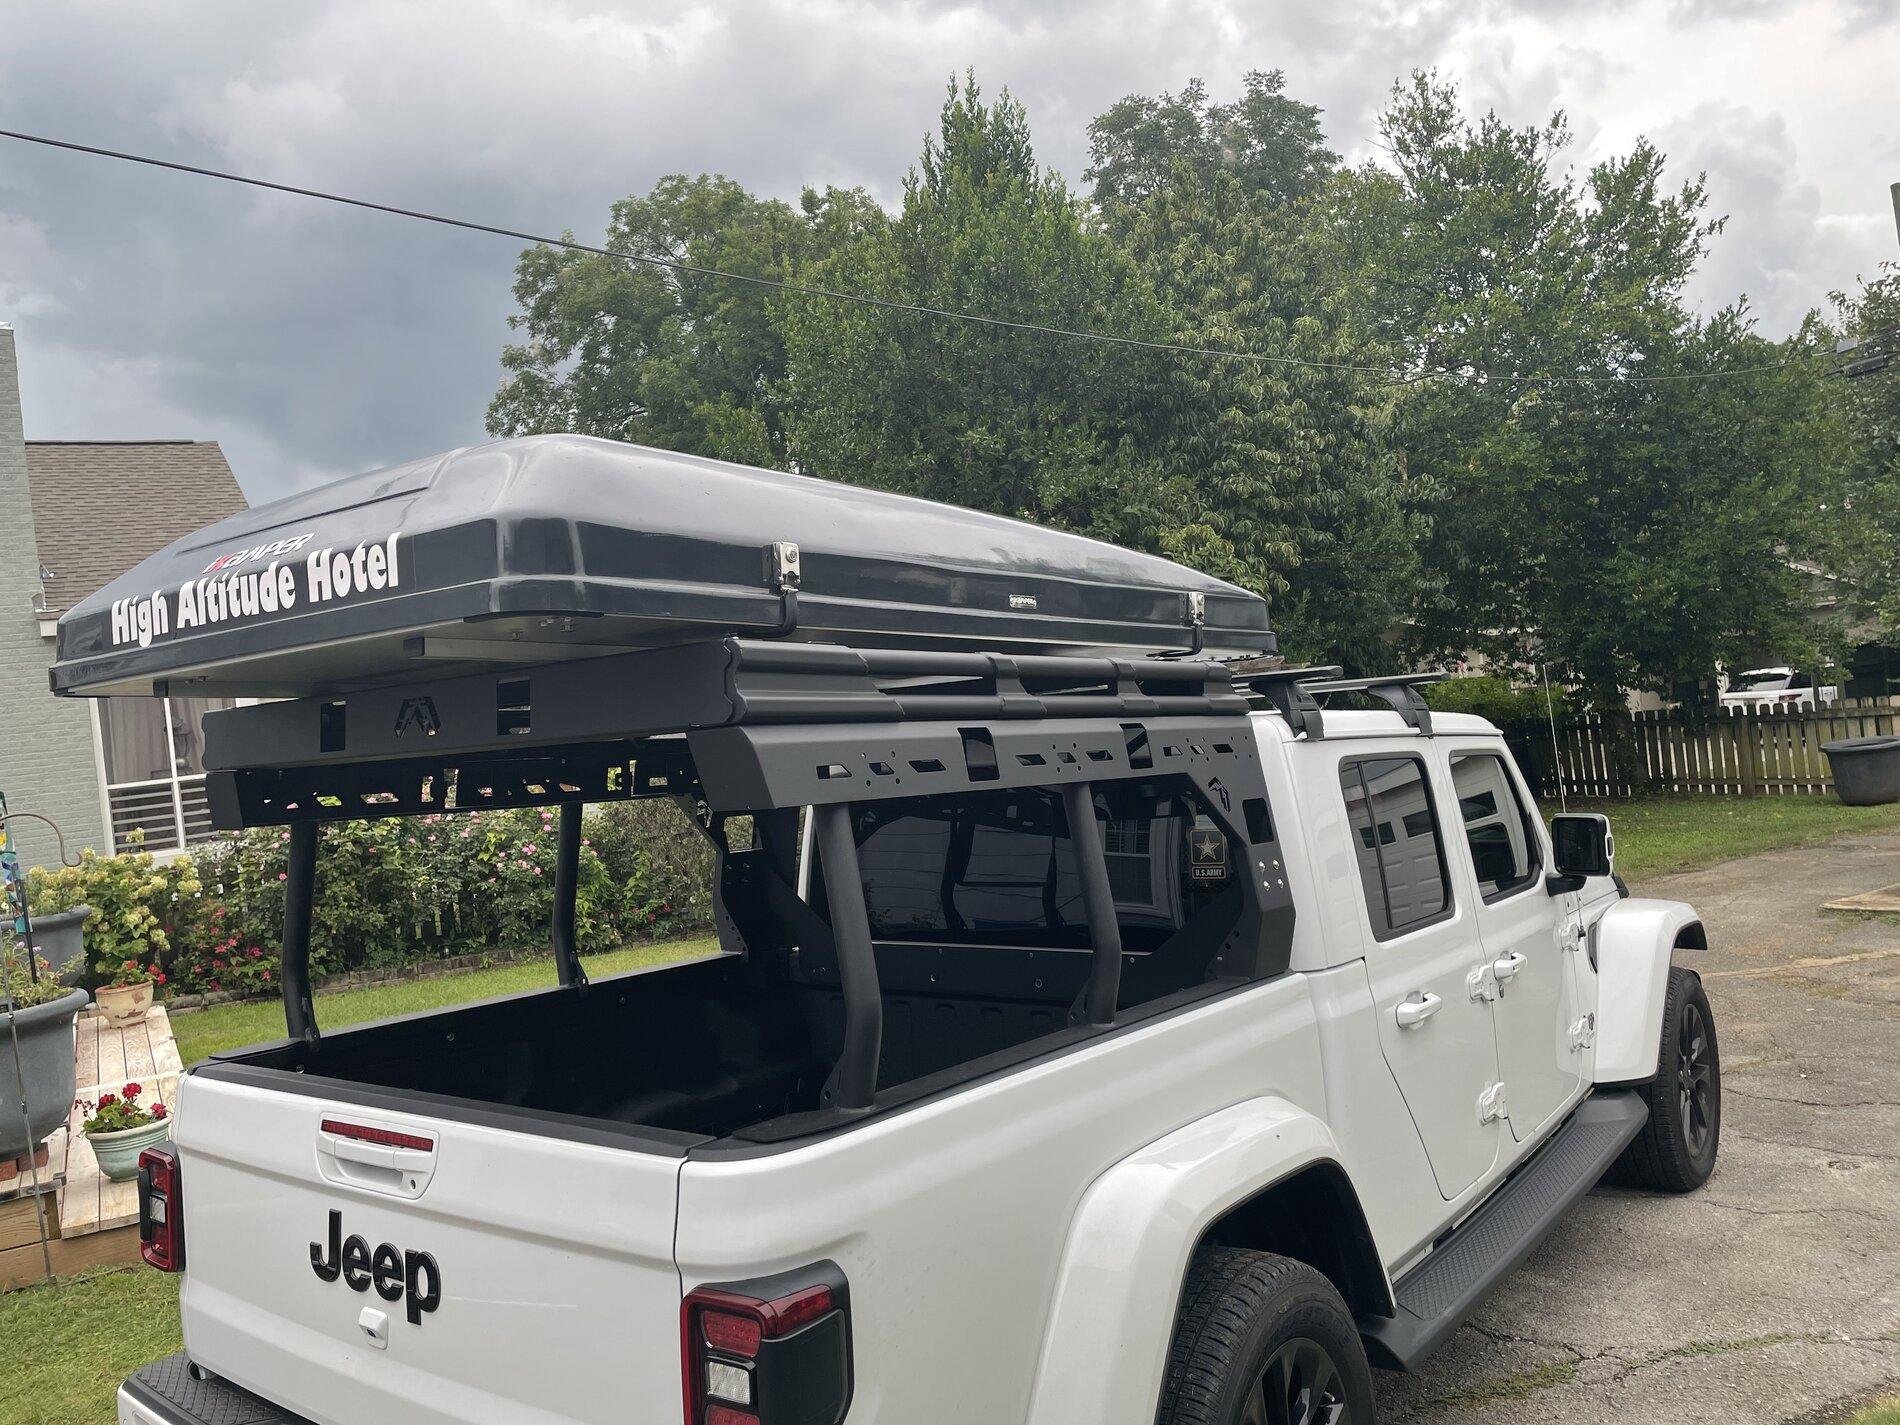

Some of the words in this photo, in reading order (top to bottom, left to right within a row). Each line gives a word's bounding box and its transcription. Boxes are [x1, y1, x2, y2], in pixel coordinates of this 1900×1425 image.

[111, 589, 169, 647] High
[176, 560, 296, 629] Altitude
[306, 531, 401, 603] Hotel
[309, 1208, 442, 1326] Jeep
